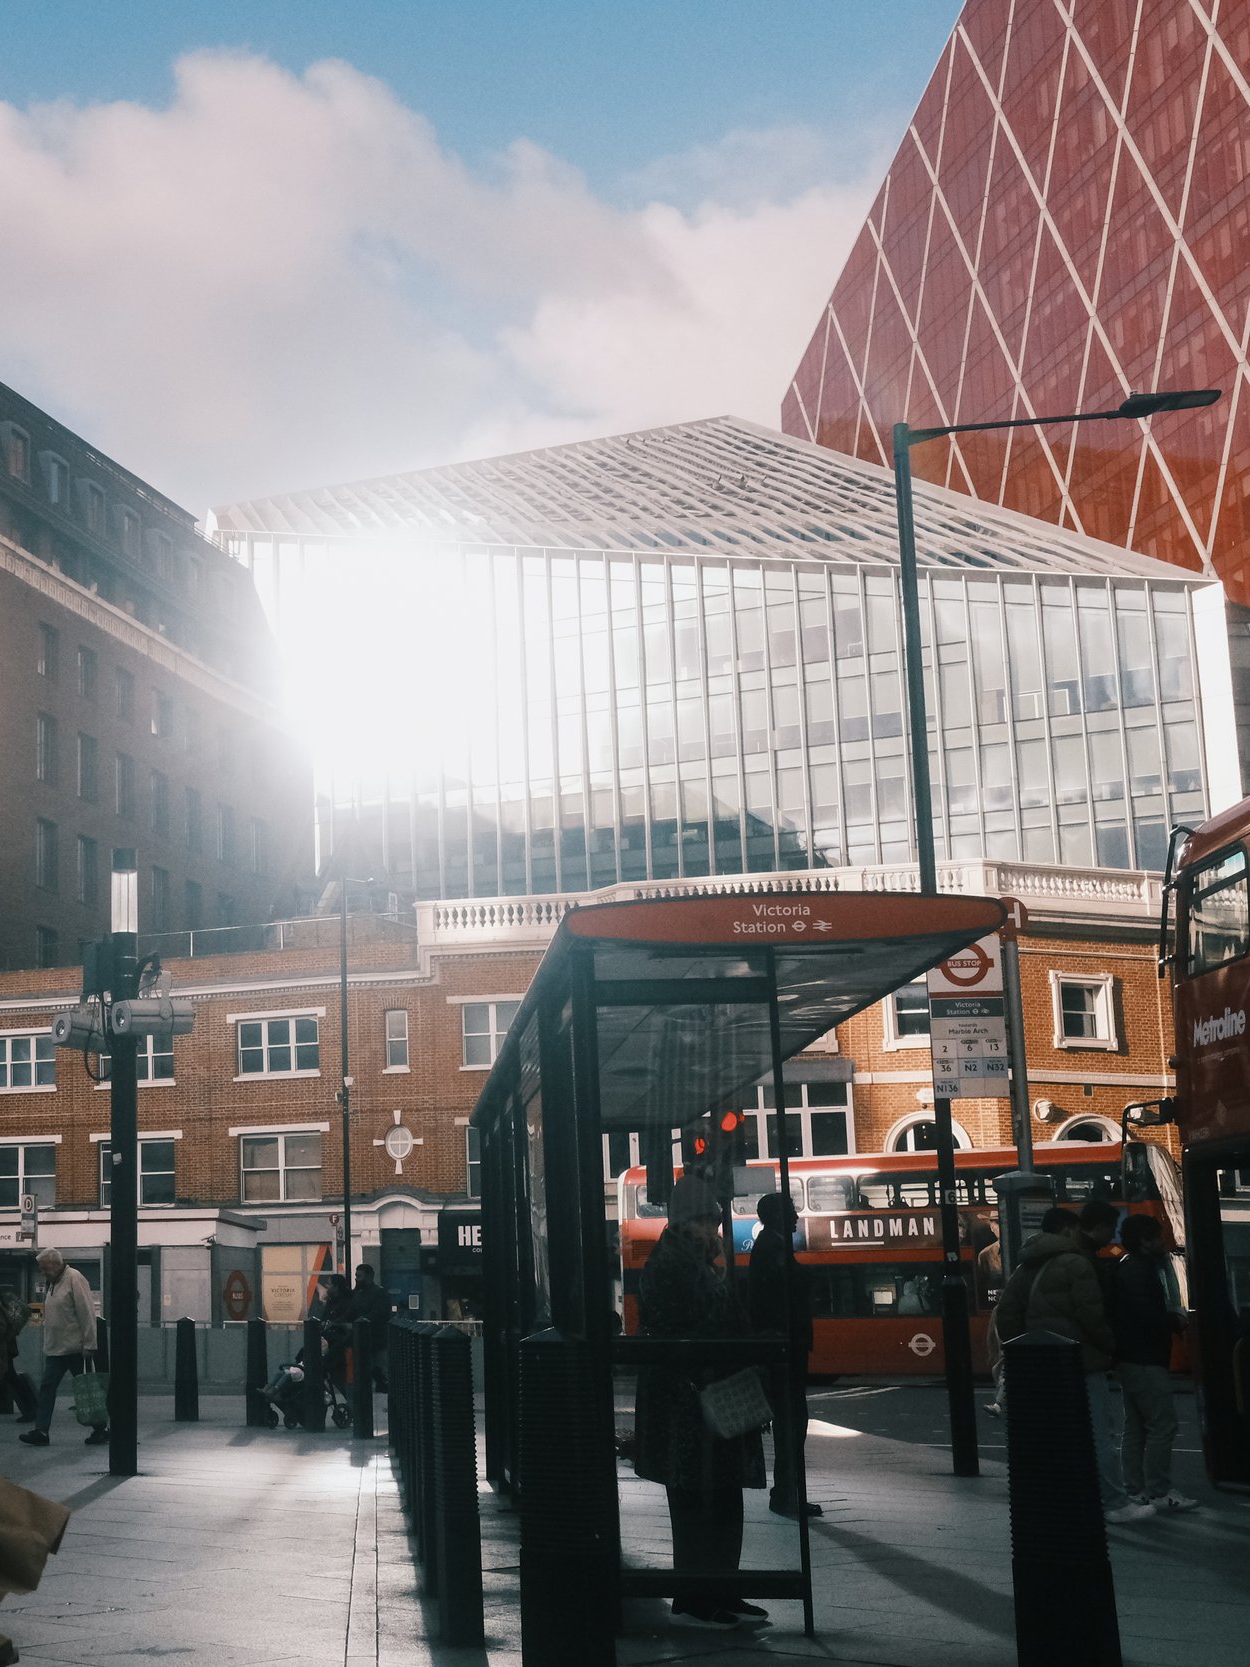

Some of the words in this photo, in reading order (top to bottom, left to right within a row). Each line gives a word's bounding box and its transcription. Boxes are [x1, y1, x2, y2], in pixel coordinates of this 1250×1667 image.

[752, 903, 811, 916] Victoria
[733, 921, 786, 933] Station
[1193, 1007, 1246, 1048] Metroline
[942, 1045, 948, 1053] 2
[967, 1044, 973, 1052] 6
[990, 1043, 999, 1051] 13
[941, 1064, 952, 1072] 36
[964, 1064, 978, 1072] N2
[986, 1063, 1005, 1071] N32
[936, 1084, 959, 1093] N136
[332, 1215, 338, 1224] F
[829, 1217, 935, 1239] LANDMAN
